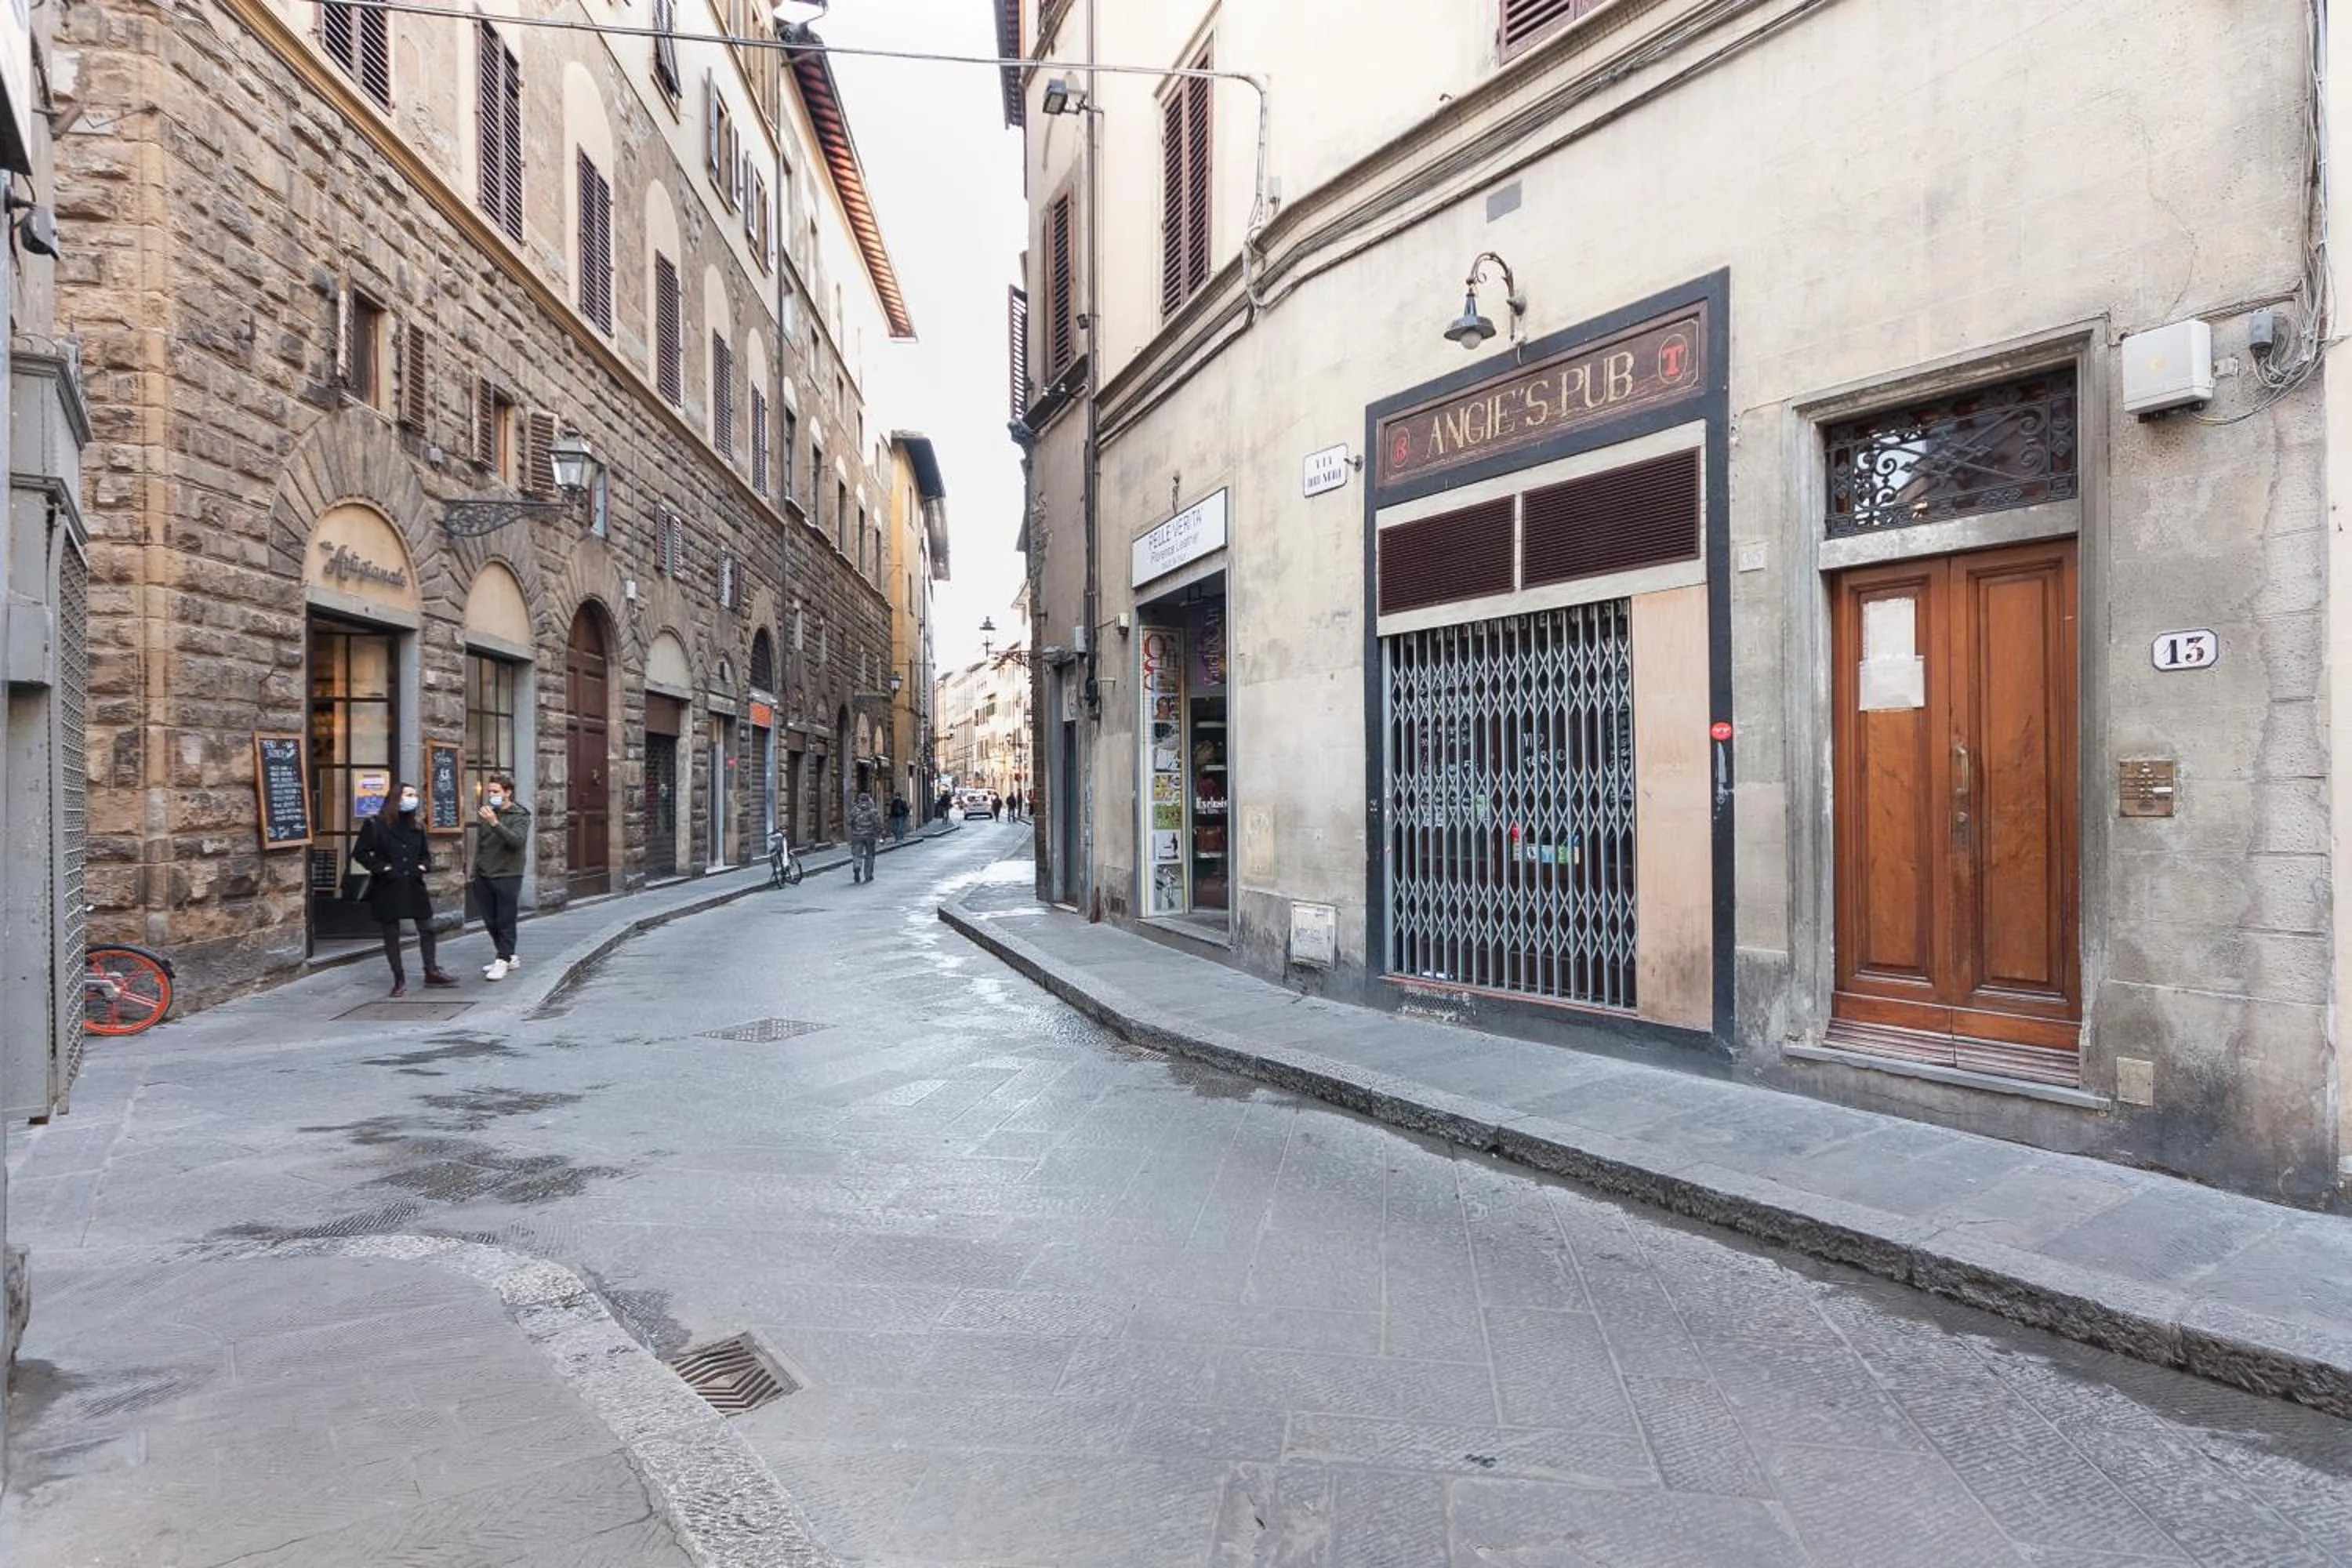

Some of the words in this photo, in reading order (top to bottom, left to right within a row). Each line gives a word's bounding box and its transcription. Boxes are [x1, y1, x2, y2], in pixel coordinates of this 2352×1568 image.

[1661, 343, 1685, 377] T
[1426, 379, 1549, 458] ANGIE'S
[1559, 351, 1635, 417] PUB
[2162, 636, 2205, 666] 13
